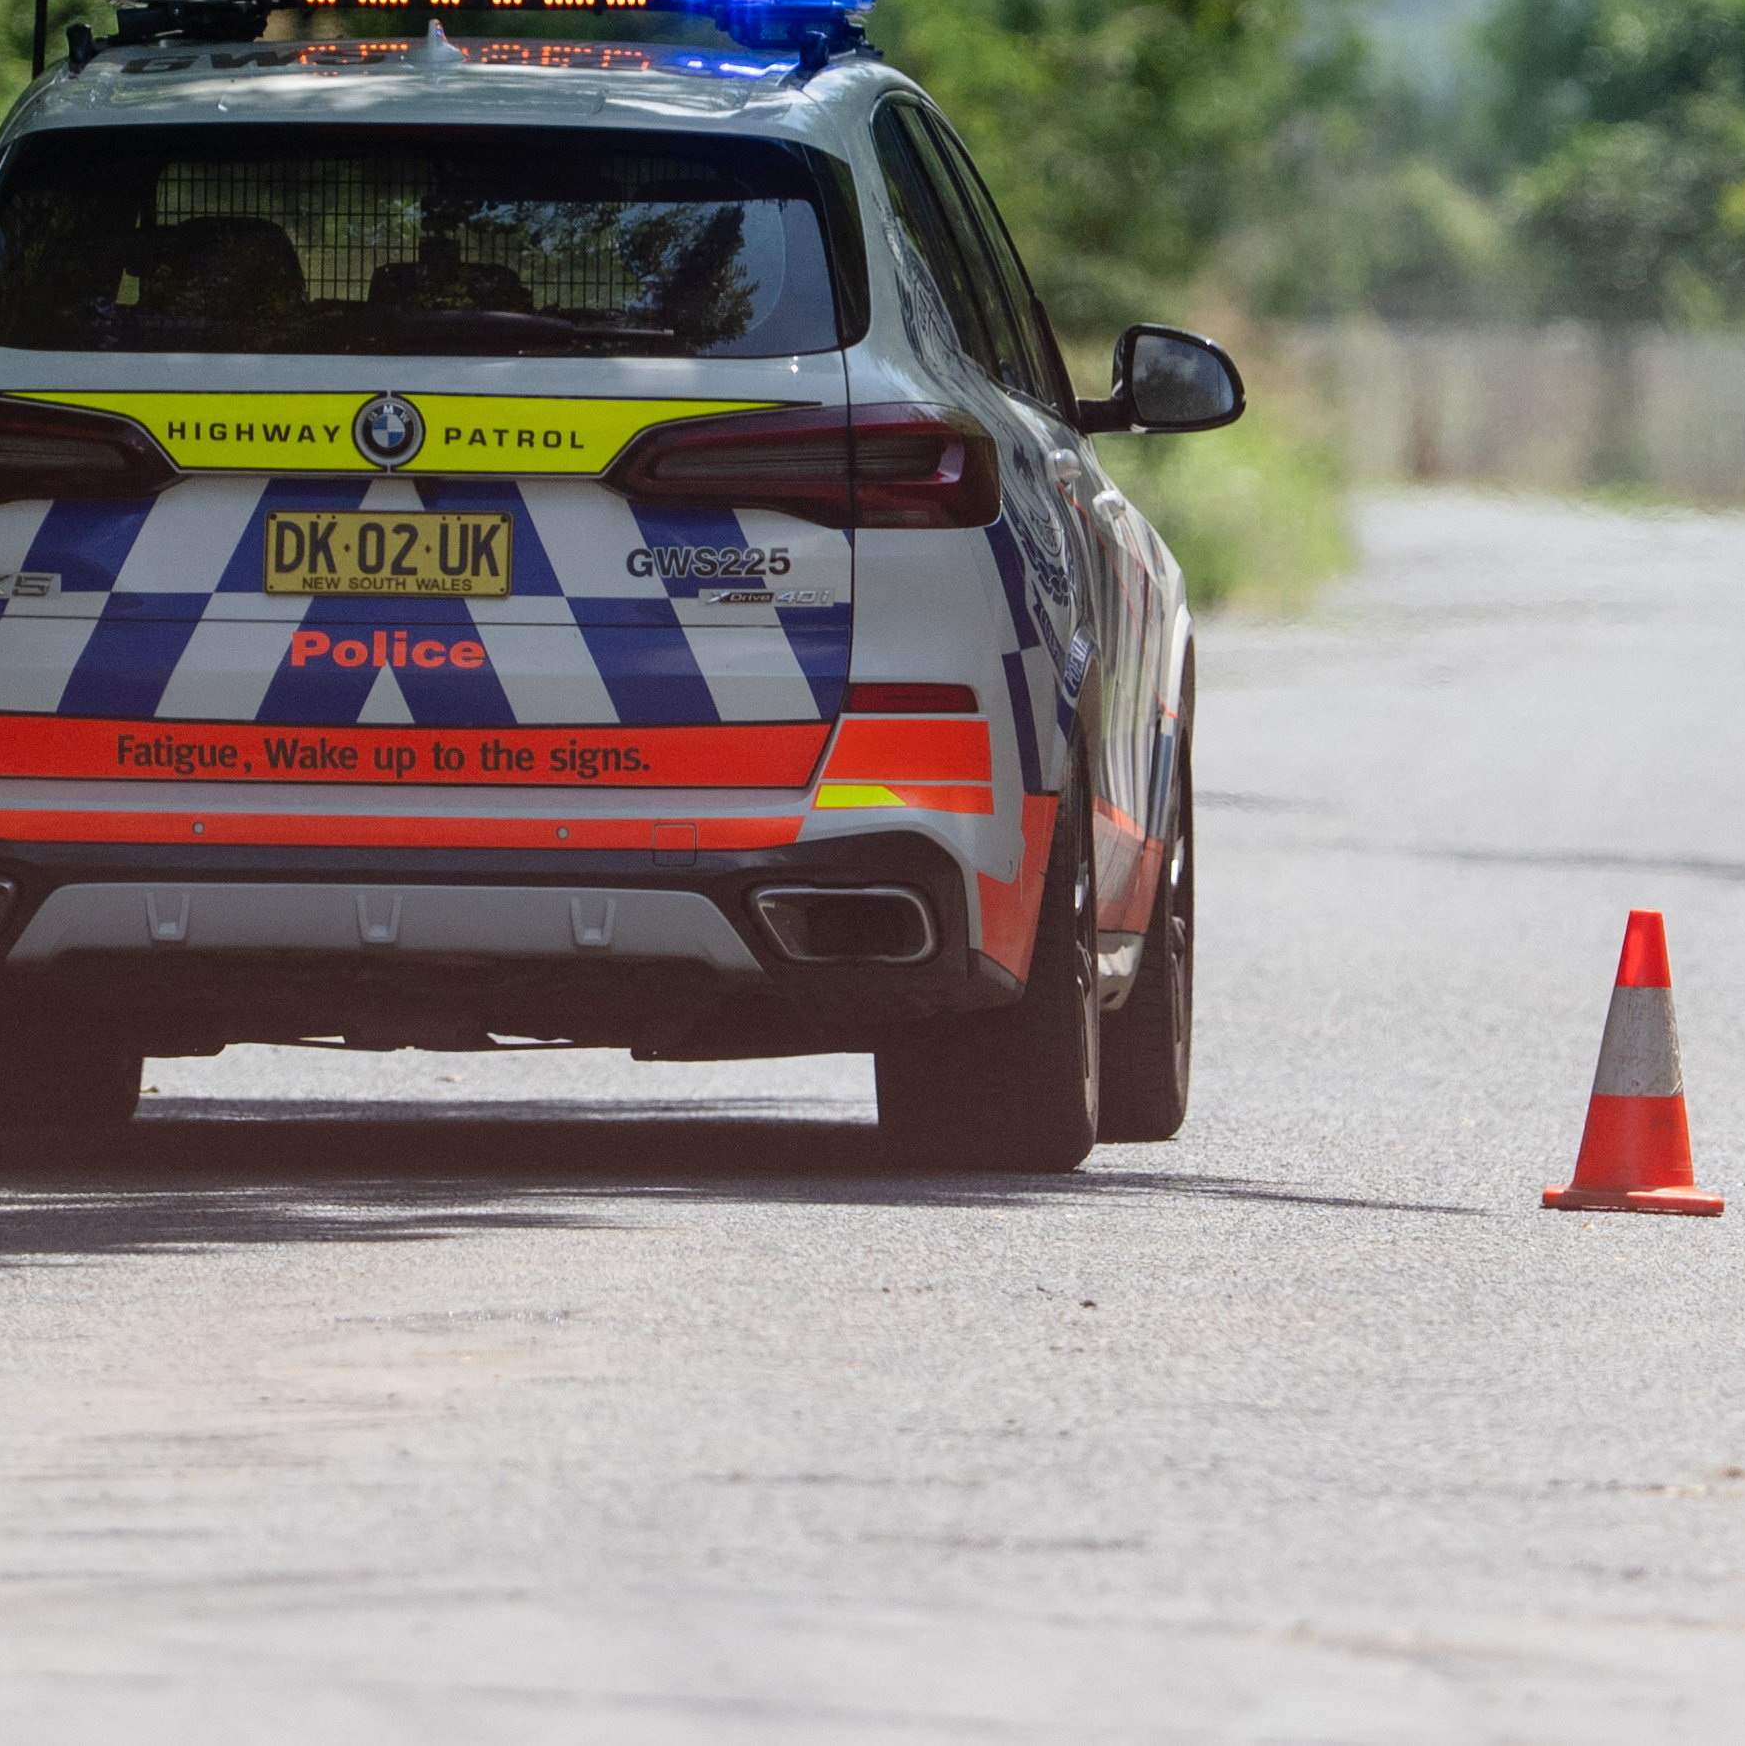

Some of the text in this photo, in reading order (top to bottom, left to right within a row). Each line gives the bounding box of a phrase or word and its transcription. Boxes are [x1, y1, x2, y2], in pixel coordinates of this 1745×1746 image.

[167, 420, 585, 450] HIGHWAY PATROL
[626, 547, 792, 578] GWS225
[302, 576, 473, 592] NEW SOUTH WALES
[290, 630, 486, 669] Police
[116, 734, 650, 780] Fatigue, Wake up to the signs.
